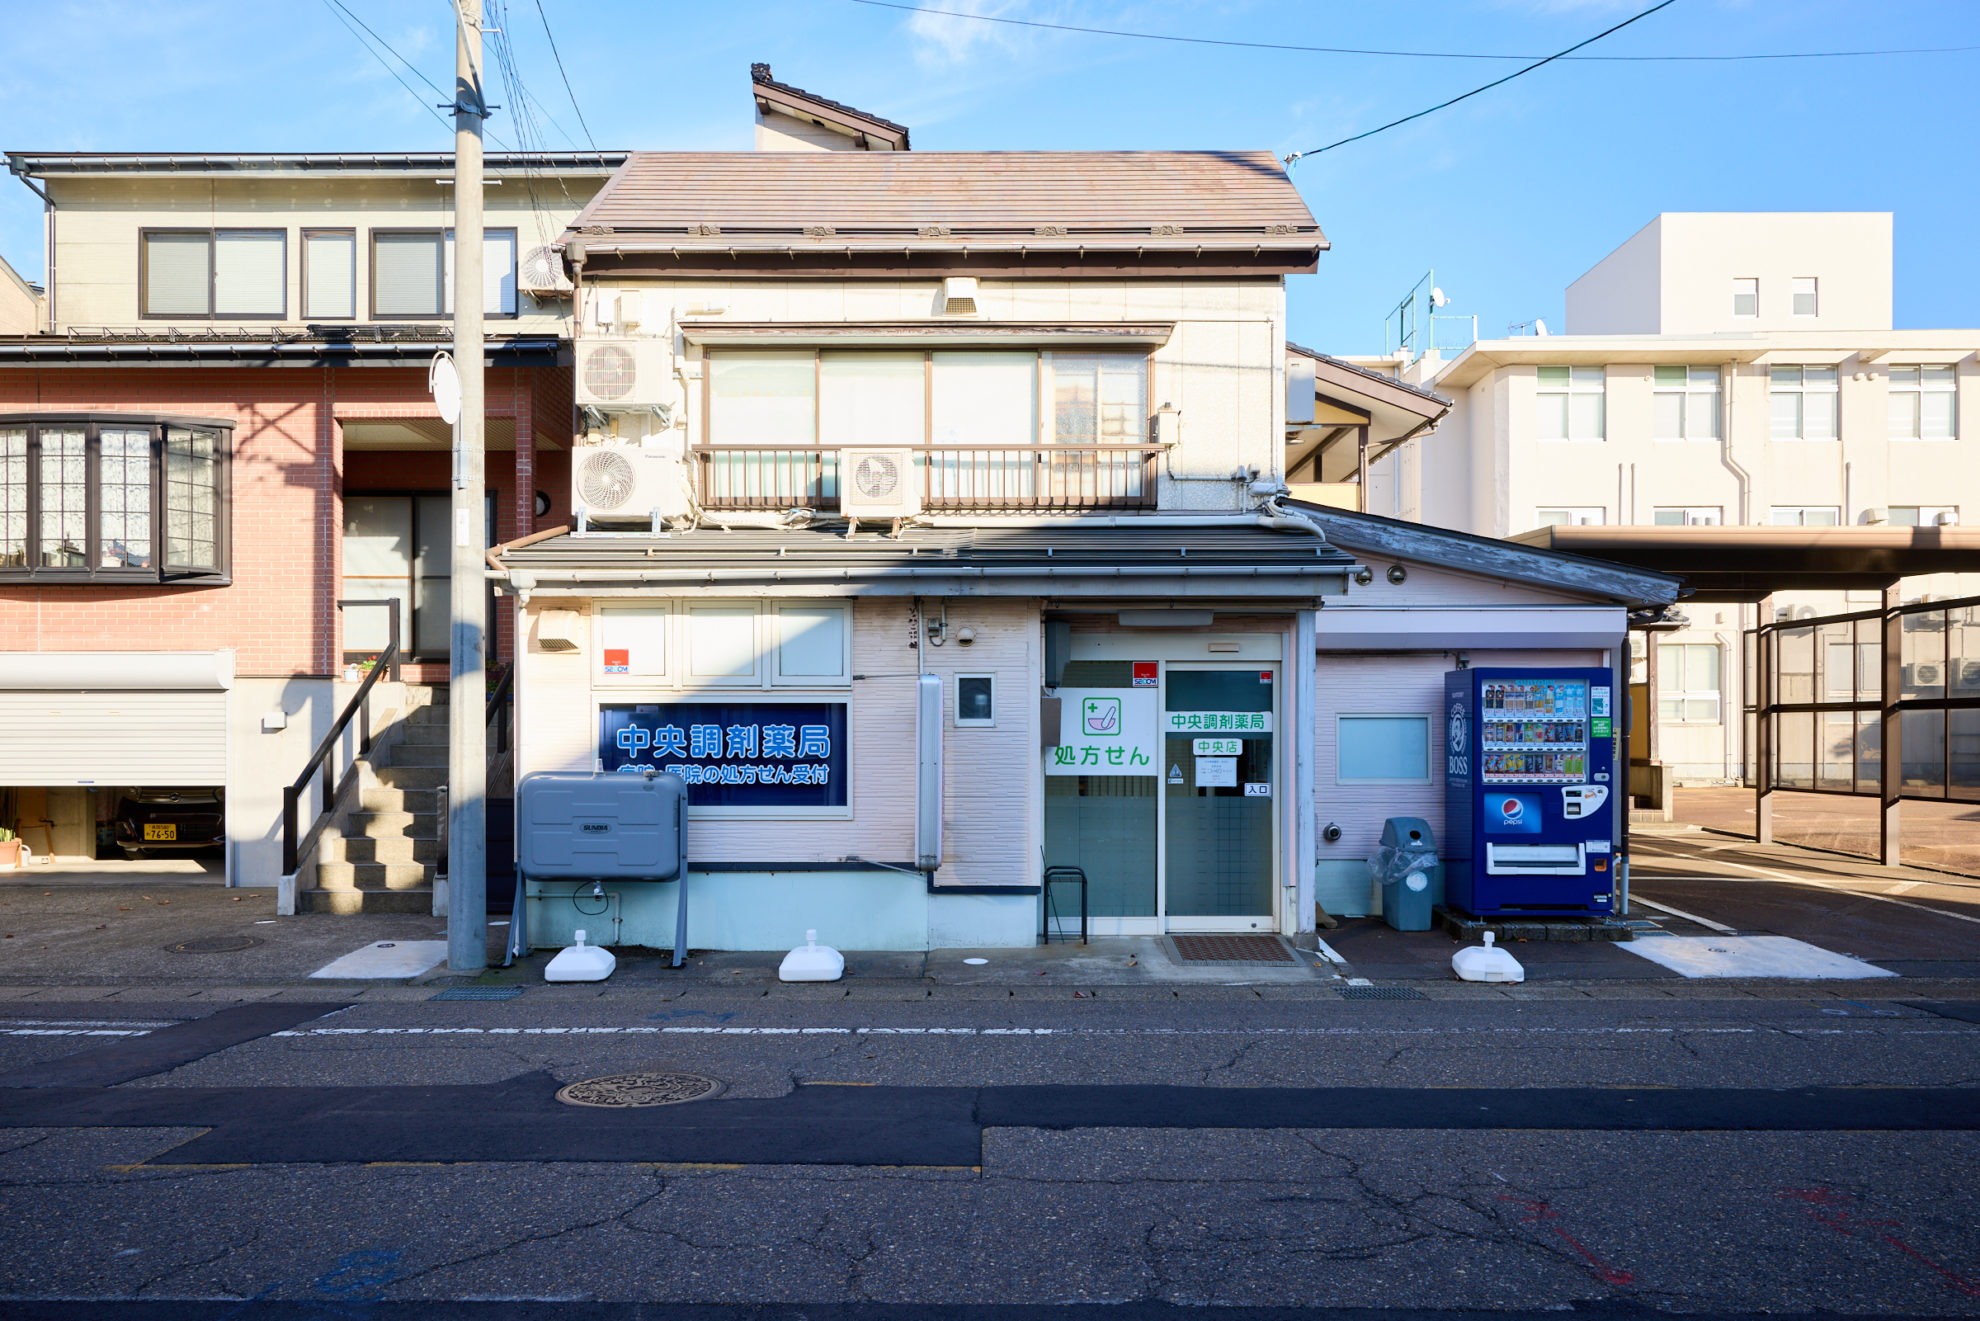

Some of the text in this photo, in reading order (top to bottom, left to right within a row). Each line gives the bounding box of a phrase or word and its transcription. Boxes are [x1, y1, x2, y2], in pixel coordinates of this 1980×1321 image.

[1171, 714, 1264, 730] 中央調剤薬局
[617, 724, 830, 758] 中央調剤薬局
[1198, 741, 1238, 753] 中央店
[1054, 745, 1150, 766] 処方せん
[1449, 756, 1468, 775] BOSS
[1248, 786, 1267, 794] 入口
[1503, 819, 1522, 827] pepsi
